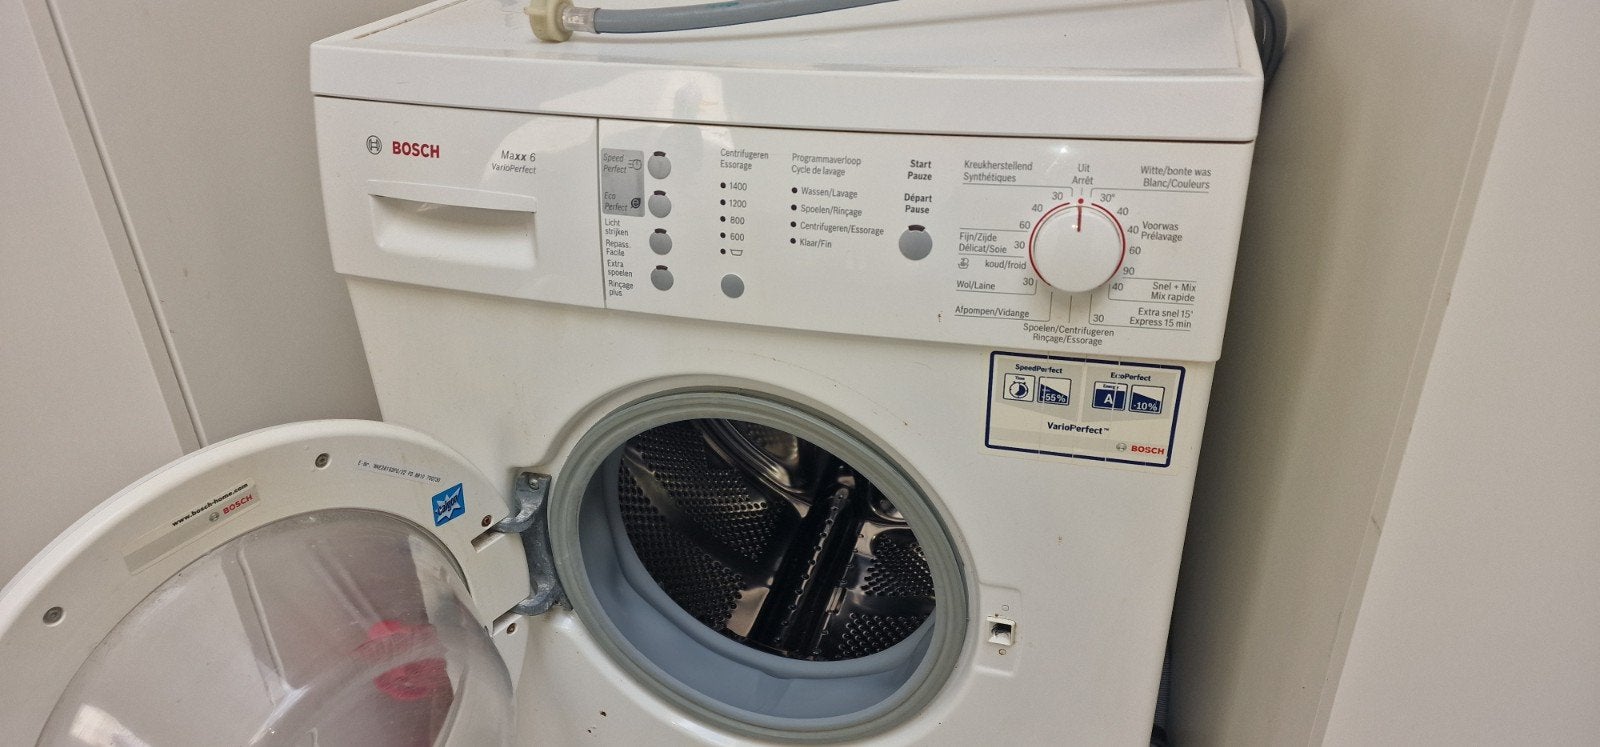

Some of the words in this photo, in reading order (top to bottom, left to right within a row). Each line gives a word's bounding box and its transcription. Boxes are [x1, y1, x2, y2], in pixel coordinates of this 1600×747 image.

[393, 141, 440, 158] BOSCH
[720, 148, 769, 160] Centrifugeren
[501, 150, 527, 161] Maxx
[530, 152, 536, 162] 6
[603, 152, 625, 163] Speed
[792, 153, 862, 166] Programmaverloop
[491, 163, 536, 174] VarioPerfect
[720, 159, 753, 171] Essorage
[910, 159, 932, 169] Start
[964, 160, 1033, 171] Kreukherstellend
[1077, 164, 1090, 173] Uit
[603, 165, 627, 174] Perfect
[791, 165, 810, 174] Cycle
[812, 166, 822, 175] de
[822, 167, 846, 177] lavage
[1141, 165, 1193, 177] Witte/bonte
[1194, 169, 1212, 177] was
[907, 171, 933, 181] Pauze
[963, 172, 1016, 183] Synthétiques
[1072, 176, 1094, 185] Arrêt
[730, 182, 748, 191] 1400
[1143, 178, 1210, 189] Blanc/Couleurs
[604, 192, 616, 200] Eco
[801, 187, 858, 199] Wassen/Lavage
[904, 192, 933, 203] Départ
[1052, 191, 1063, 200] 30
[604, 203, 628, 211] Perfect
[729, 199, 747, 208] 1200
[1031, 204, 1043, 213] 40
[801, 205, 862, 218] Spoelen/Rinçage
[905, 205, 930, 214] Pause
[1116, 207, 1129, 216] 40
[605, 218, 620, 226] Licht
[730, 216, 745, 225] 800
[1019, 221, 1031, 230] 60
[800, 222, 884, 236] Centrifugeren/Essorage
[1127, 225, 1139, 234] 40
[1142, 221, 1179, 231] Voorwas
[605, 228, 629, 237] strijken
[730, 233, 745, 241] 600
[959, 232, 997, 242] Fijn/Zijde
[1141, 231, 1183, 242] Prélavage
[800, 238, 832, 248] Klaar/Fin
[1014, 241, 1025, 249] 30
[606, 248, 625, 256] Facile
[958, 243, 1007, 254] Délicat/Soie
[1129, 246, 1141, 255] 60
[607, 260, 624, 268] Extra
[985, 259, 1027, 270] koud/froid
[608, 270, 633, 278] spoelen
[1123, 266, 1135, 275] 90
[609, 280, 634, 290] Rinçage
[956, 280, 996, 290] Wol/Laine
[1022, 277, 1034, 286] 30
[1112, 282, 1124, 291] 40
[1152, 281, 1172, 291] Snel
[1181, 283, 1197, 292] Mix
[609, 289, 623, 297] plus
[1151, 291, 1166, 300] Mix
[1168, 293, 1195, 302] rapide
[955, 305, 1030, 319] Afpompen/Vidange
[1138, 307, 1160, 317] Extra
[1162, 309, 1180, 318] snel
[1093, 314, 1105, 323] 30
[1130, 316, 1163, 327] Express
[1164, 318, 1175, 328] 15
[1176, 319, 1192, 328] min
[1023, 322, 1115, 337] Spoelen/Centrifugeren
[1033, 333, 1103, 346] Rinçage/Essorage
[1015, 363, 1063, 374] SpeedPerfect
[1103, 393, 1113, 405] A
[1133, 401, 1158, 411] -10%
[1131, 445, 1165, 455] BOSCH
[172, 483, 249, 527] www.bosch-home.com
[222, 494, 254, 515] BOSCH
